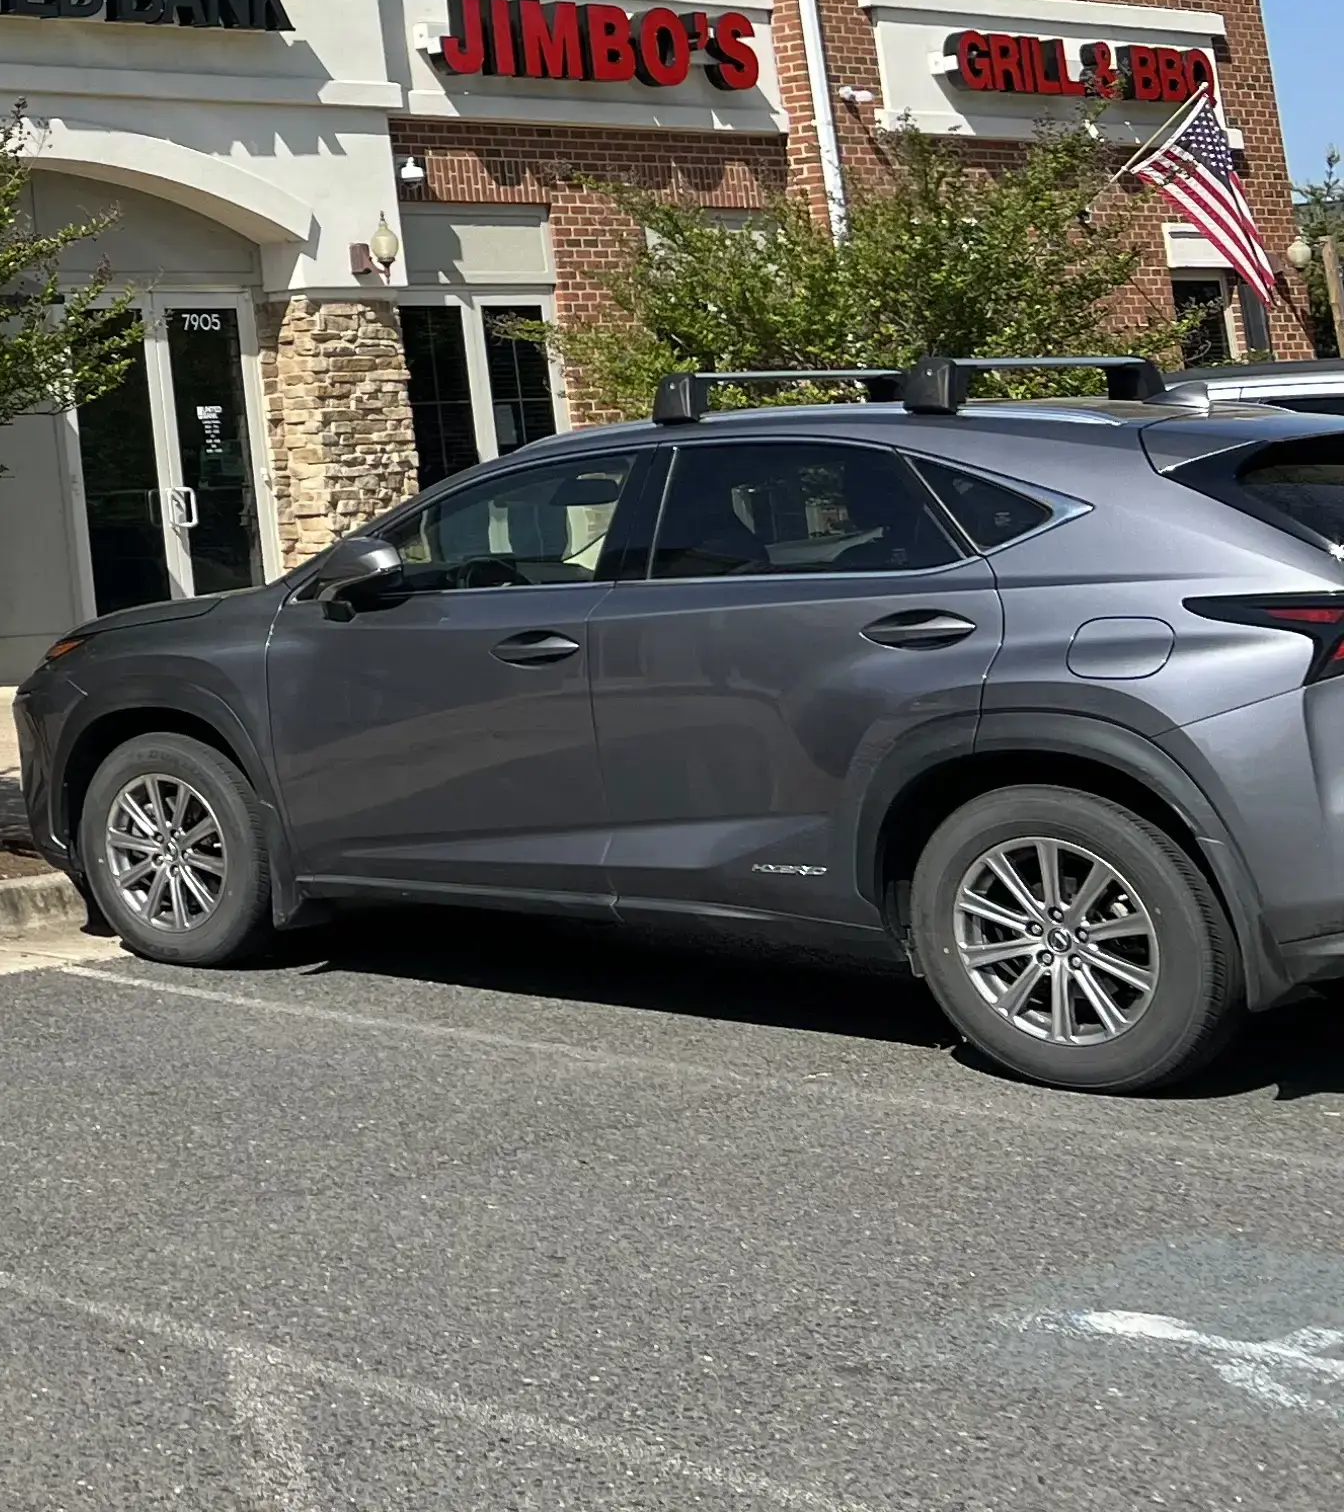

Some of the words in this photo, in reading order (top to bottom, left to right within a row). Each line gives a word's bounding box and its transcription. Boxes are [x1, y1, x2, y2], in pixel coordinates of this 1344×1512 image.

[944, 29, 1085, 97] GRILL
[1080, 41, 1127, 100] &
[182, 314, 221, 331] 7905
